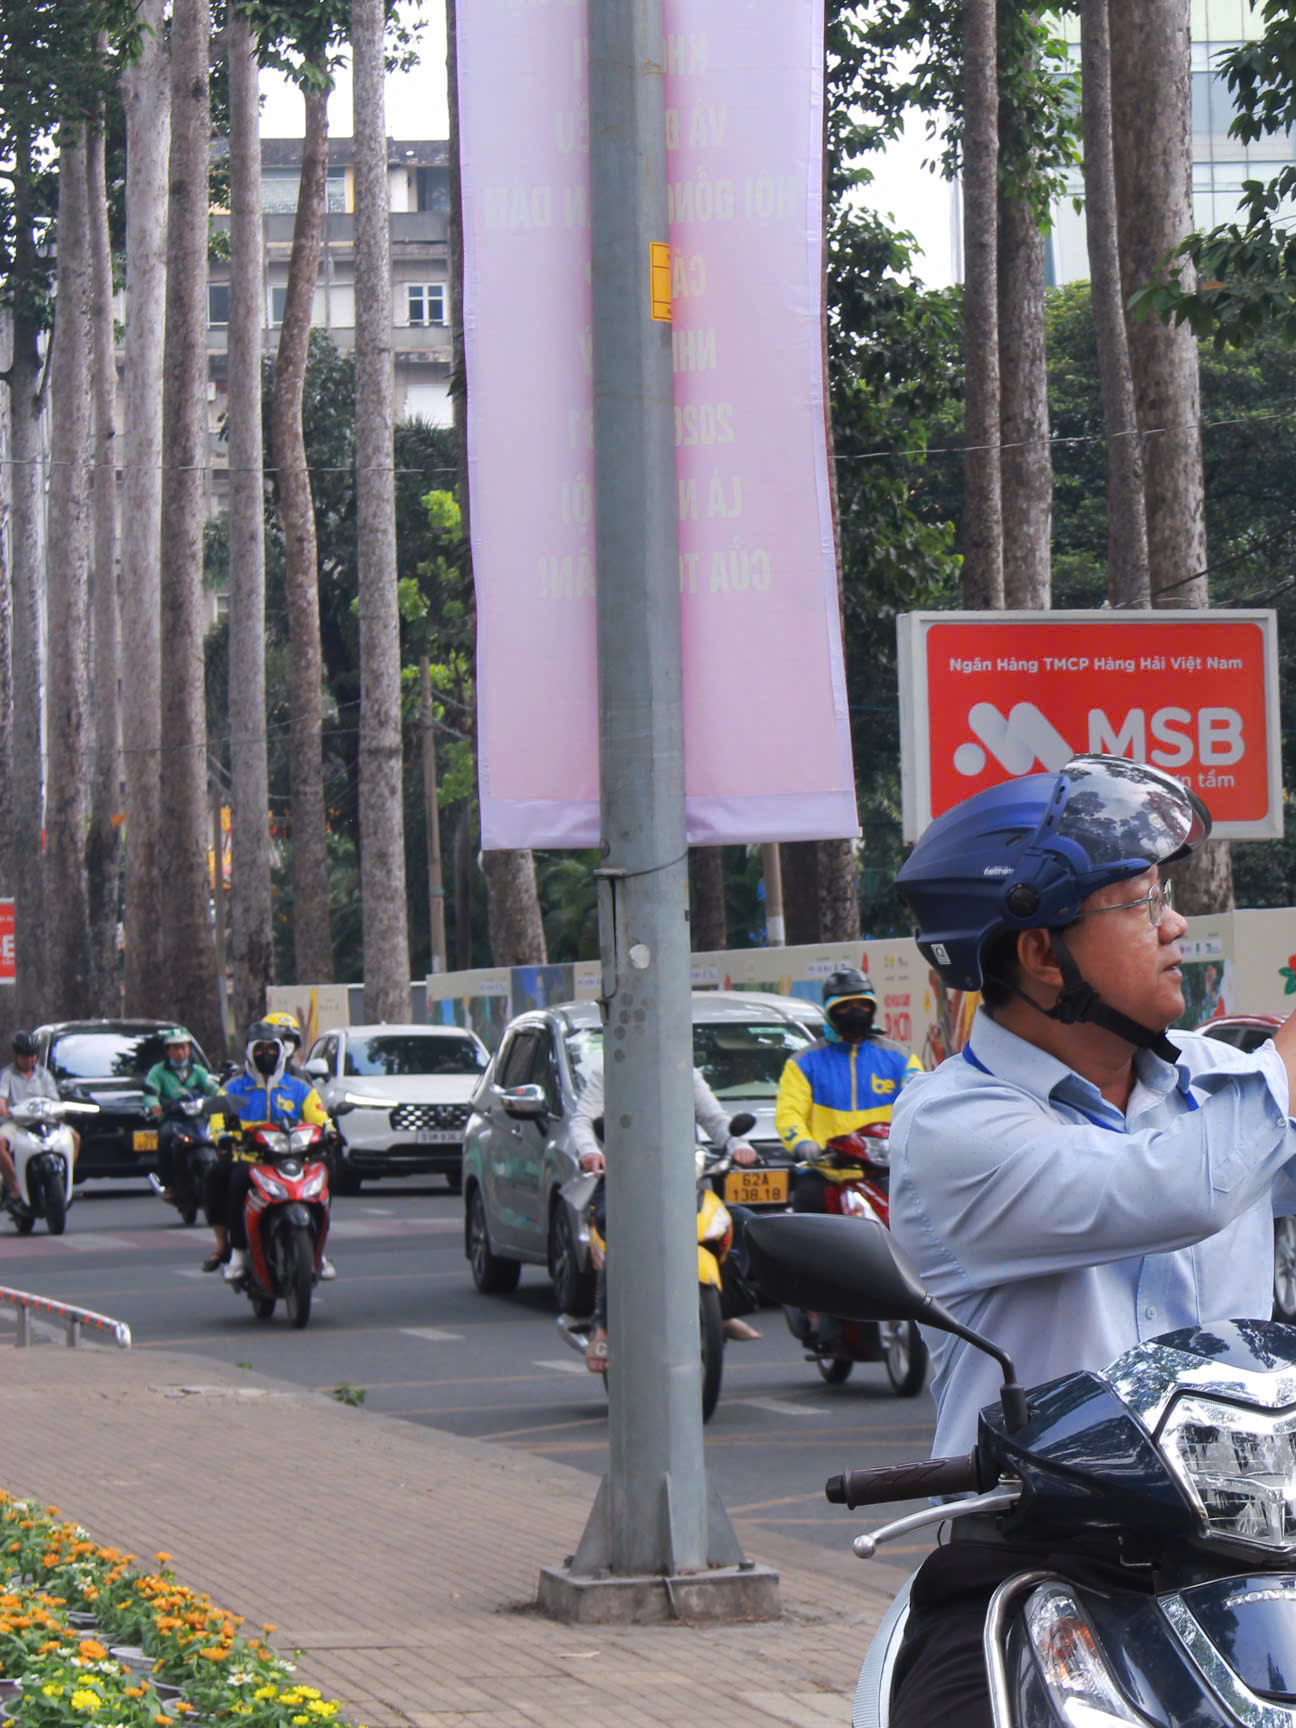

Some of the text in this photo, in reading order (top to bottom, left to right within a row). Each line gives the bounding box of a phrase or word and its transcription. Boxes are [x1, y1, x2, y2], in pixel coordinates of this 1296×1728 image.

[950, 657, 993, 674] Ngân
[997, 656, 1039, 673] Hàng
[1043, 657, 1089, 671] TMCP
[1094, 656, 1136, 673] Hàng
[1170, 655, 1201, 672] Việt
[1206, 656, 1243, 670] Nam
[1088, 706, 1245, 768] MSB
[871, 1073, 896, 1095] be
[743, 1173, 769, 1187] 62A
